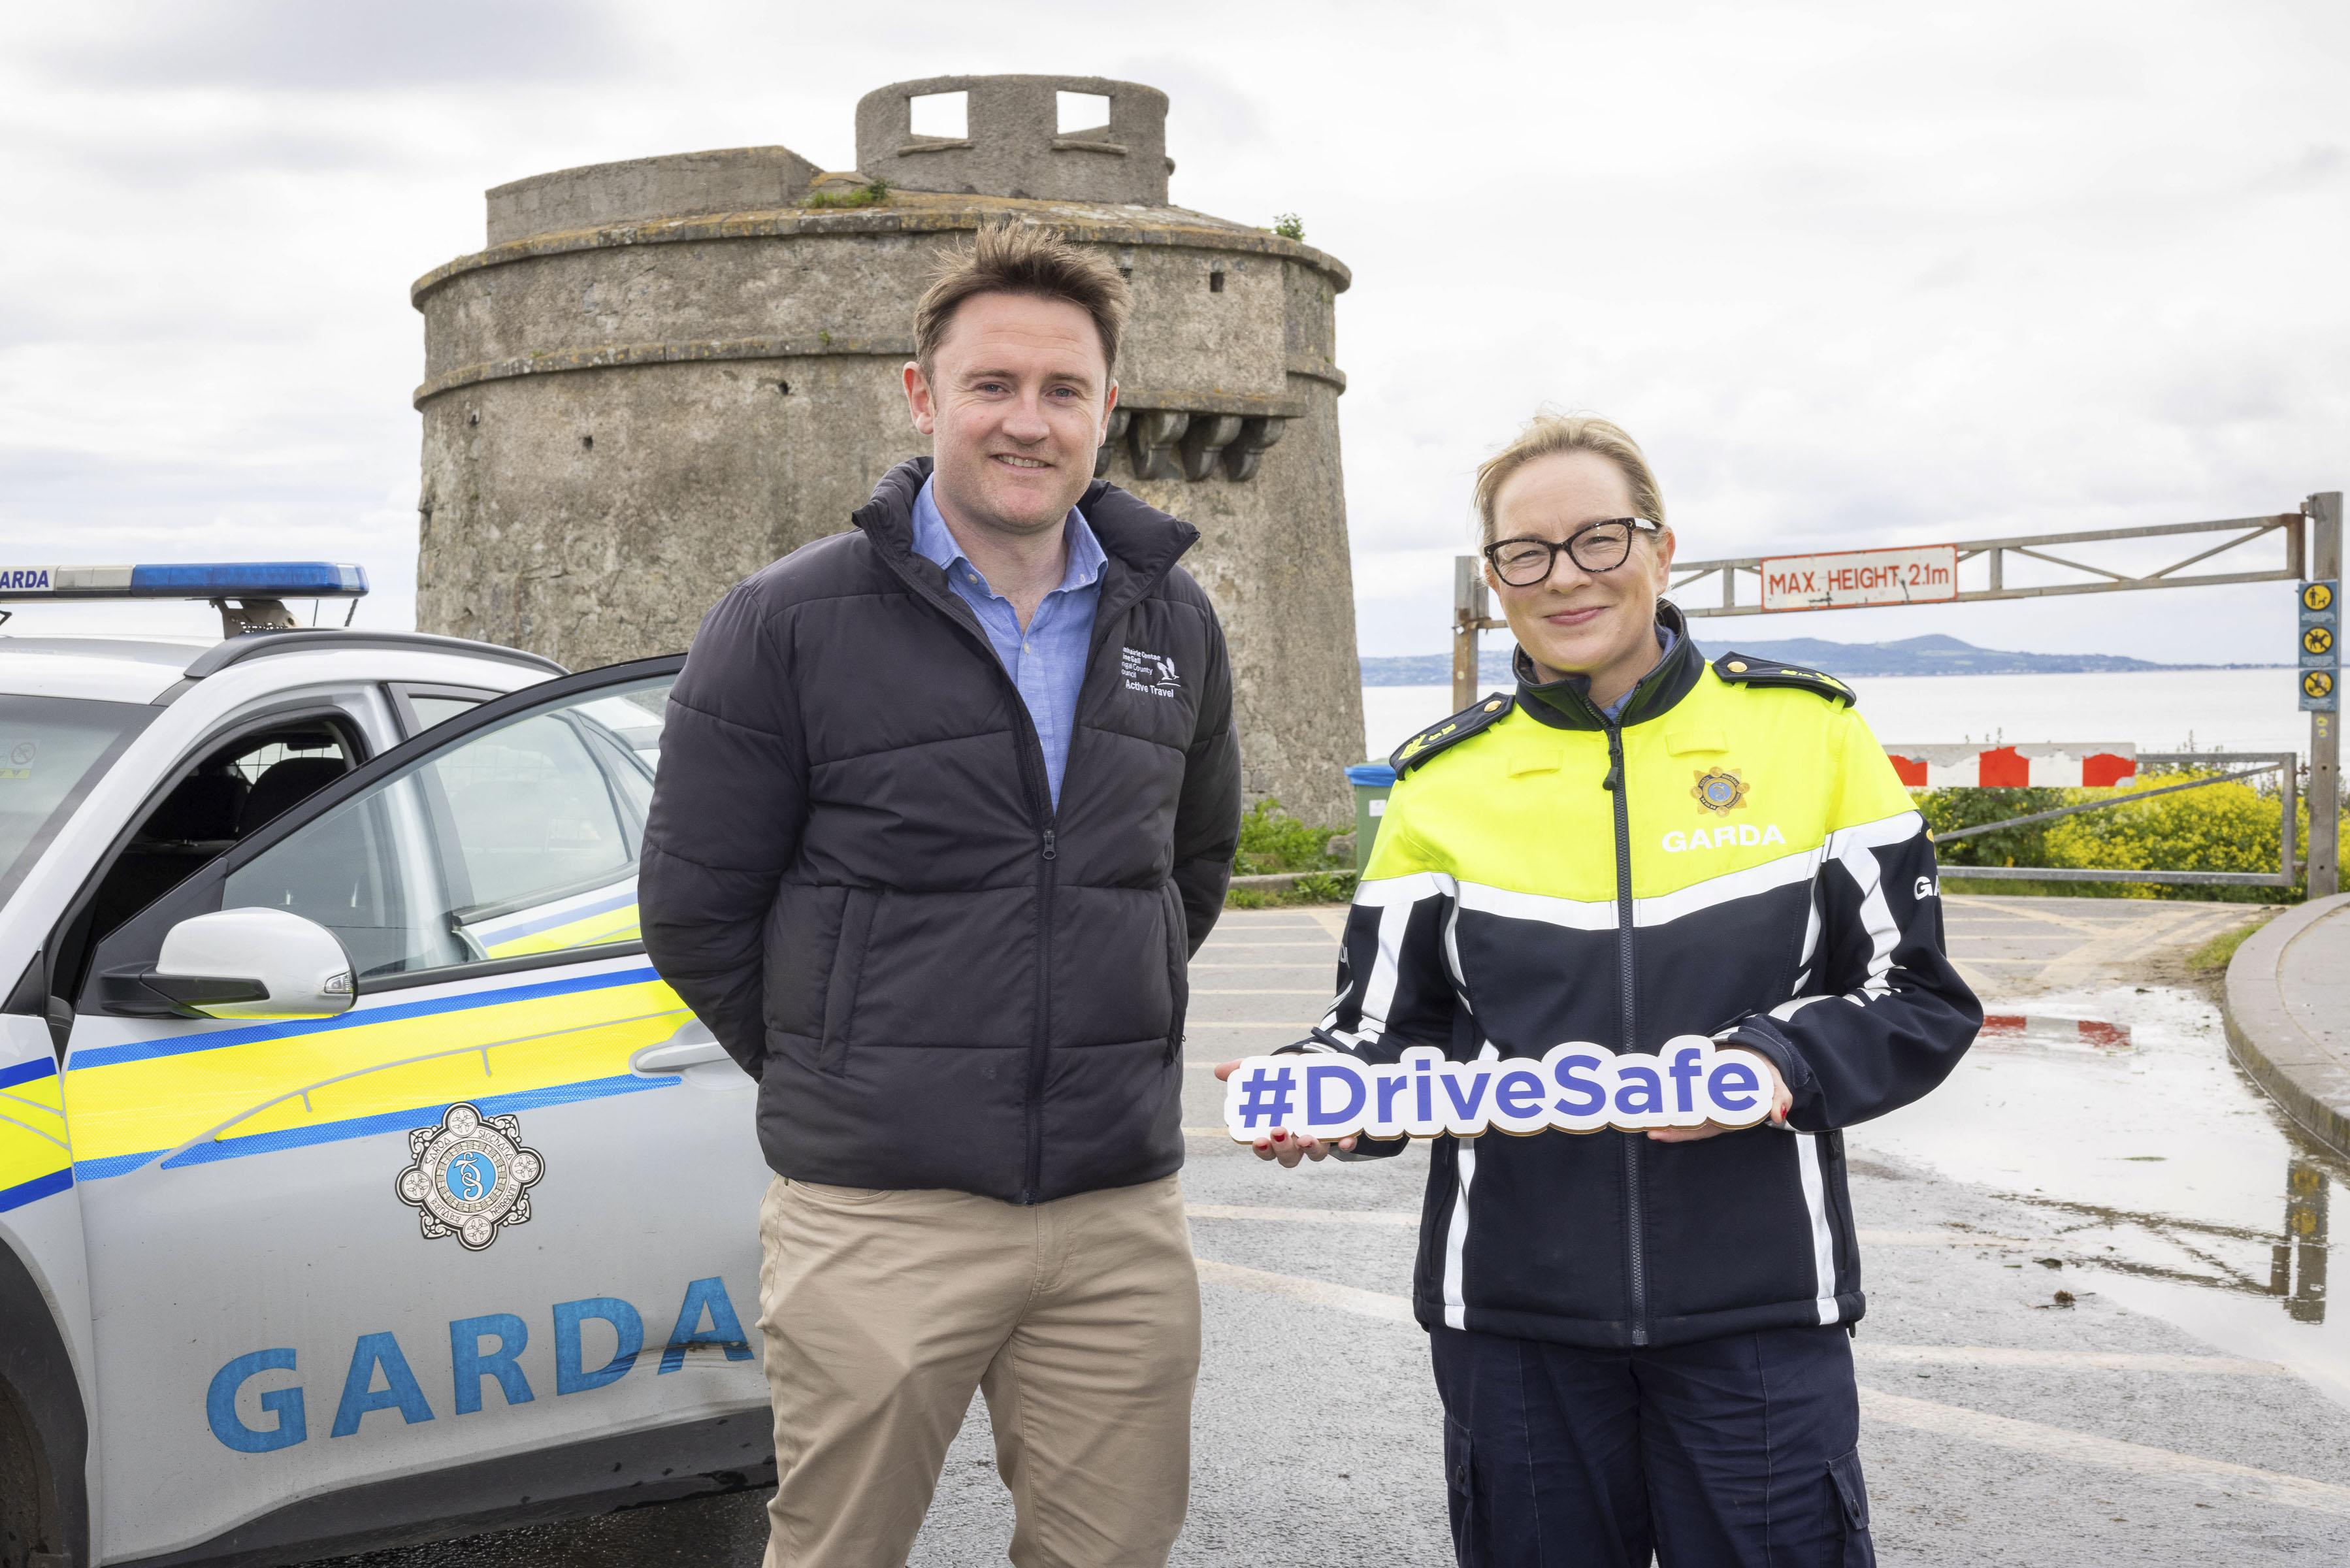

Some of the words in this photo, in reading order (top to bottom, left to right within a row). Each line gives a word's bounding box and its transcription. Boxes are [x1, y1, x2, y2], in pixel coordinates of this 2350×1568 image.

[1769, 571, 1821, 595] MAX.
[1829, 565, 1899, 591] HEIGHT
[1908, 563, 1949, 585] 2.1m
[1132, 663, 1153, 676] County
[1126, 679, 1149, 693] Active
[1149, 685, 1174, 698] Travel
[1661, 823, 1786, 853] GARDA
[1238, 1047, 1760, 1128] #DriveSafe
[206, 1275, 755, 1454] GARDA
